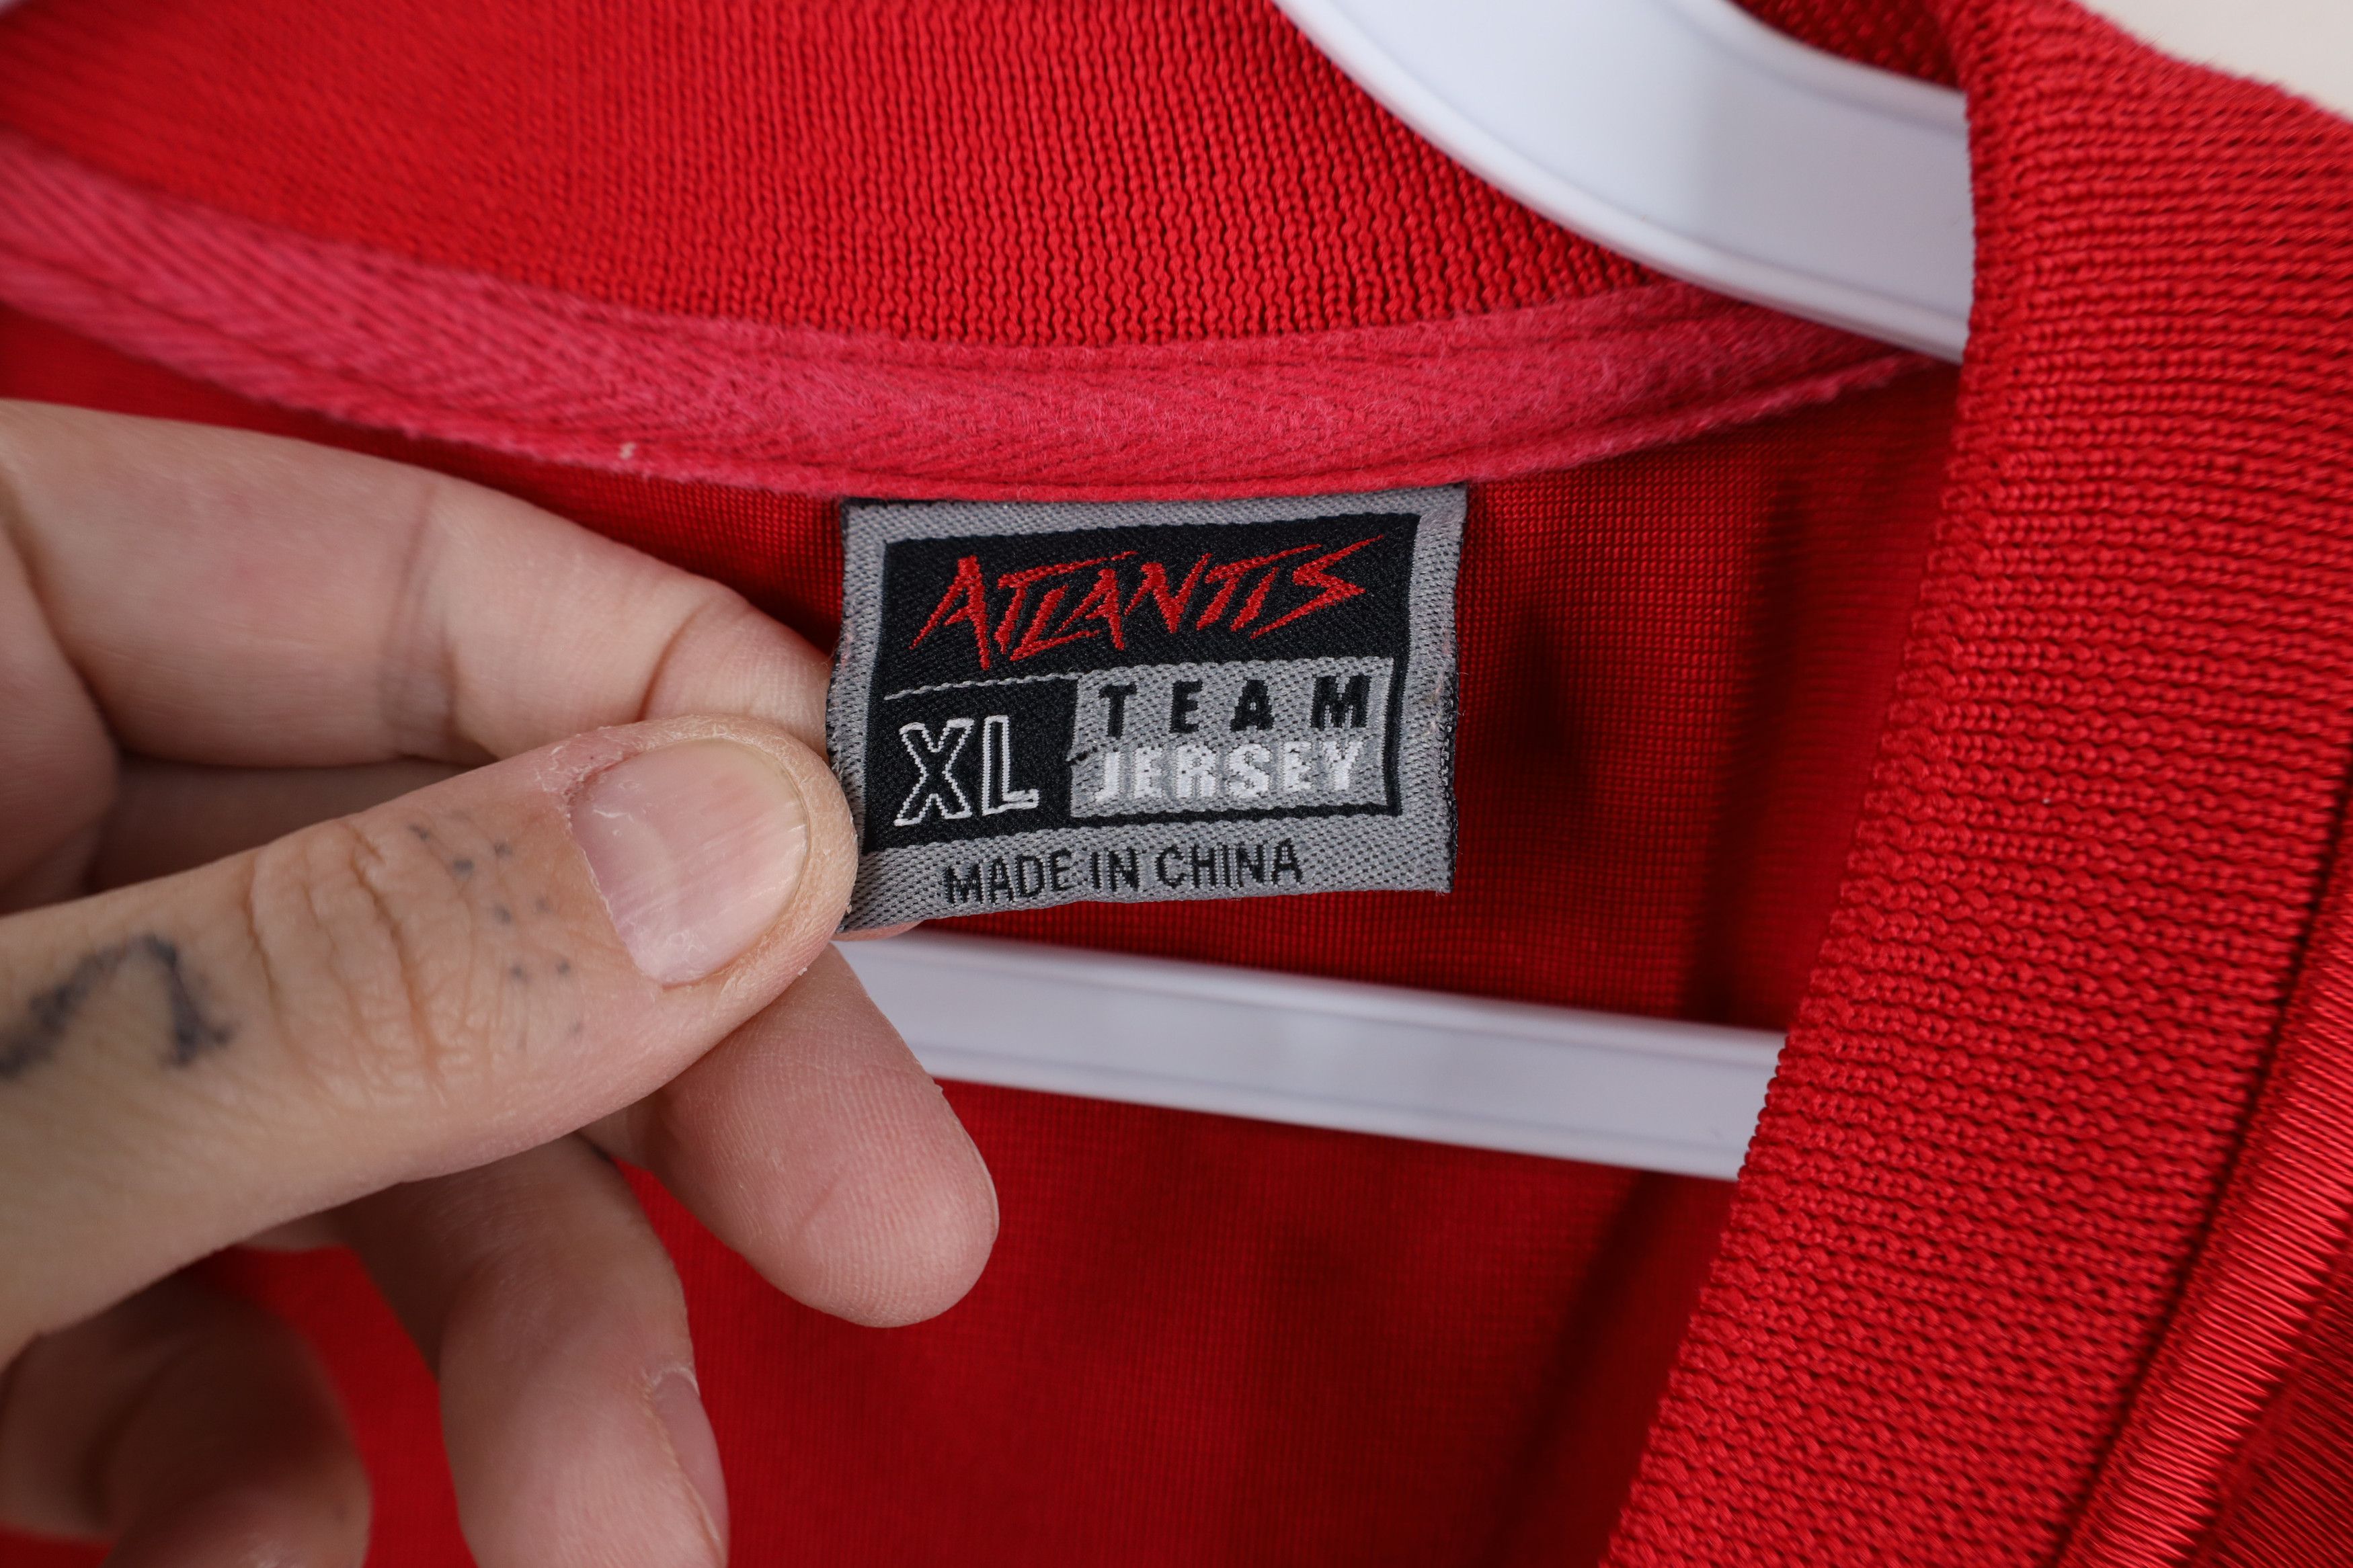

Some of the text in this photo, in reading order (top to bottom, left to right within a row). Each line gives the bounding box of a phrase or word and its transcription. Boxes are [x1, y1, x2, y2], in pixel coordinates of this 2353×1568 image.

[908, 535, 1384, 670] ATLANTIS
[1099, 674, 1371, 739] TEAM
[893, 714, 1040, 827] XL
[1092, 740, 1365, 804] JERSEY
[945, 837, 1304, 906] MADE IN CHINA
